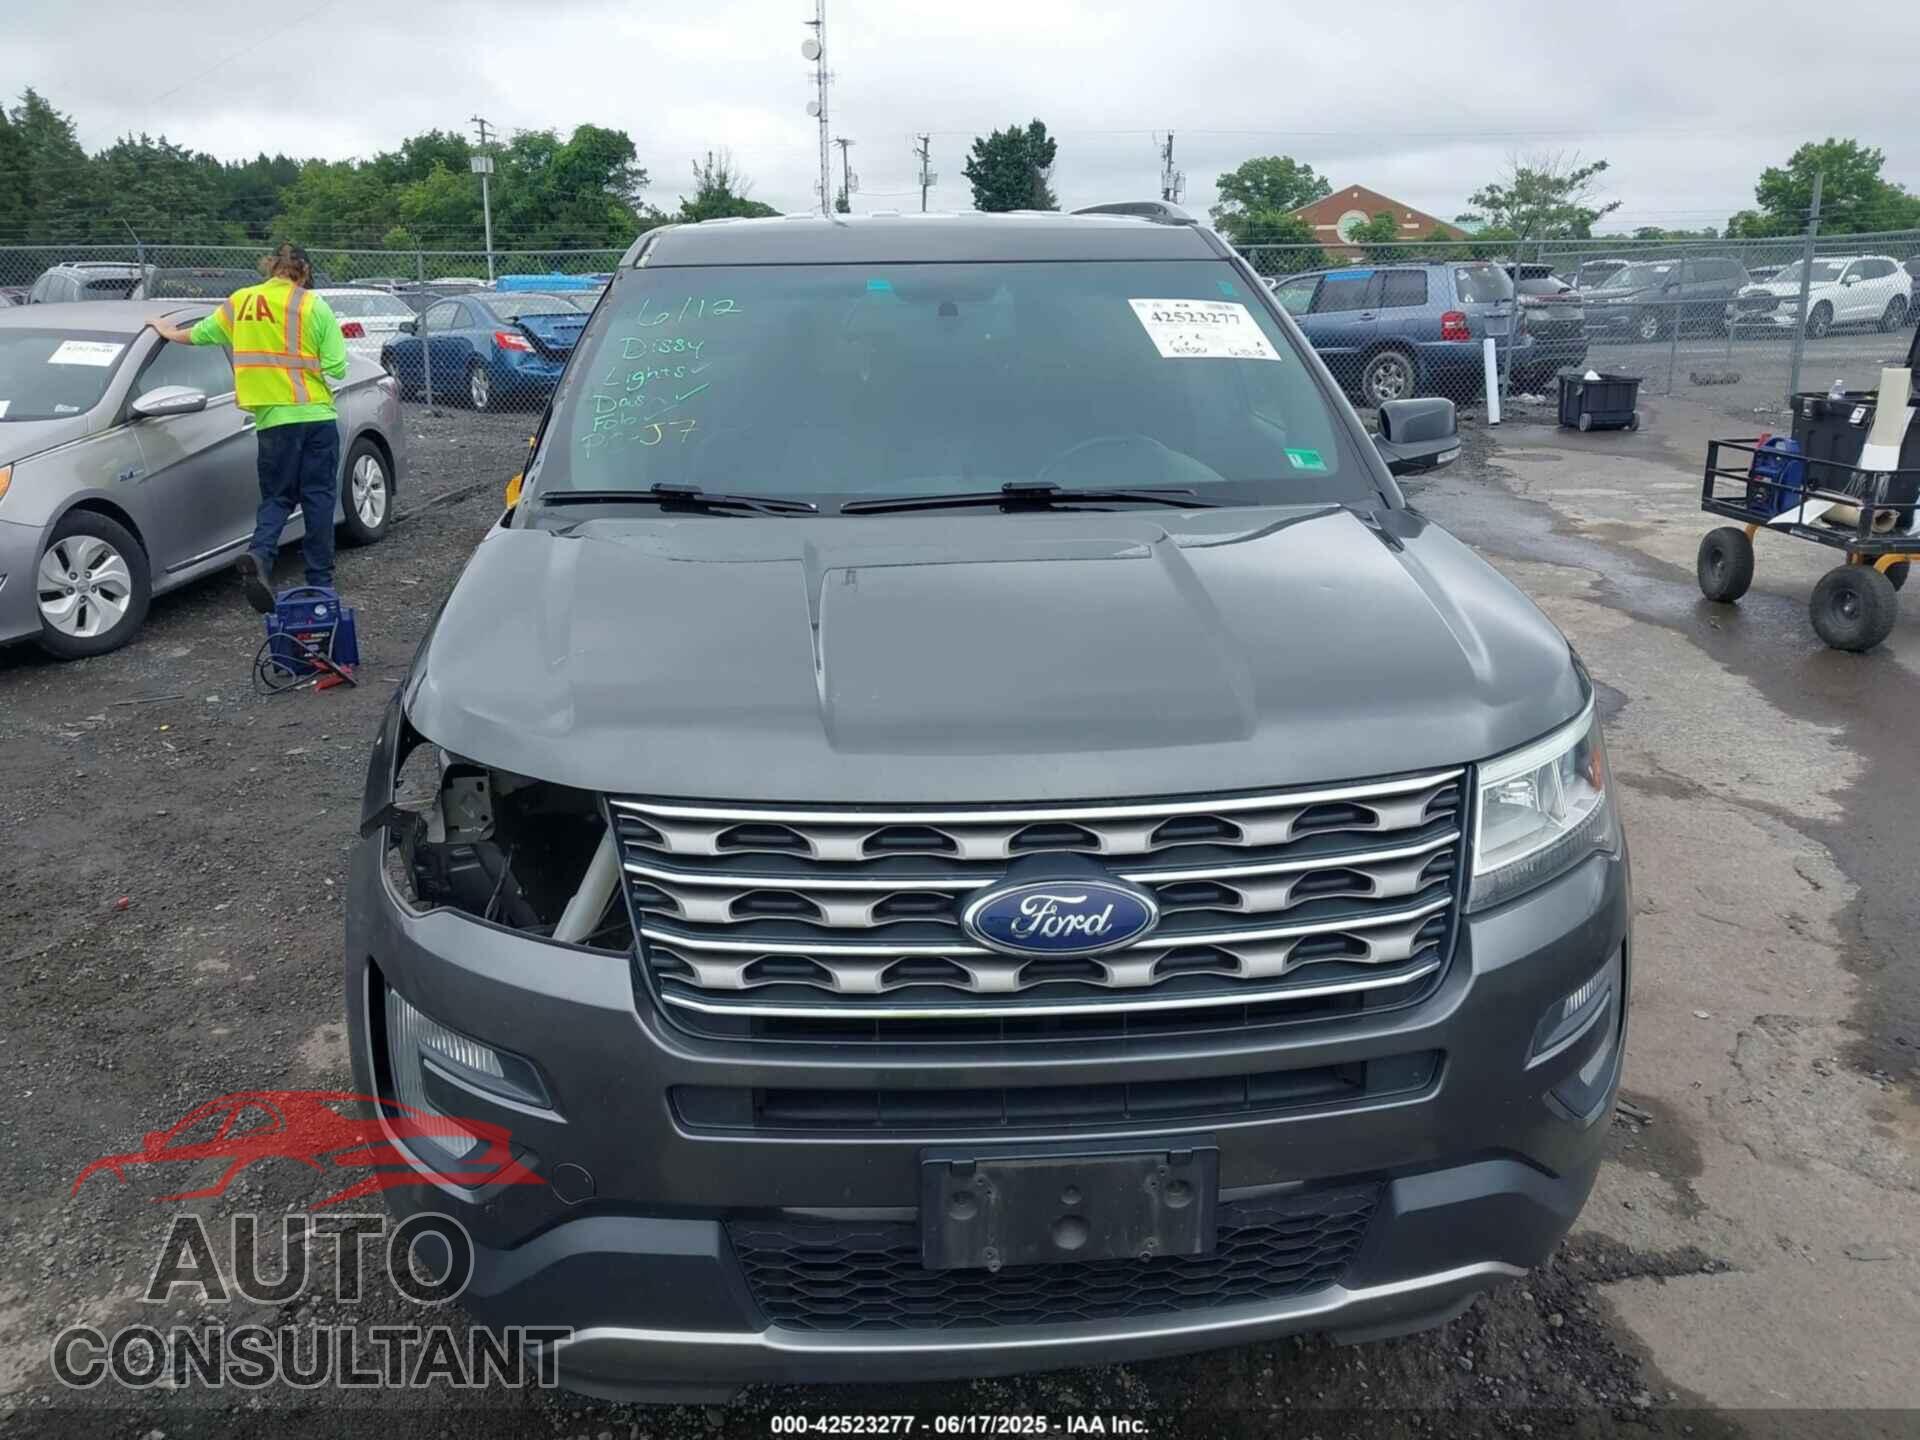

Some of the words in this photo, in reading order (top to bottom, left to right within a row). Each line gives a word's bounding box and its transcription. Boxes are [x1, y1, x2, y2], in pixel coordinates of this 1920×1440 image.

[637, 296, 744, 327] 6/12
[1151, 311, 1241, 325] 42523277
[1010, 894, 1115, 939] Ford
